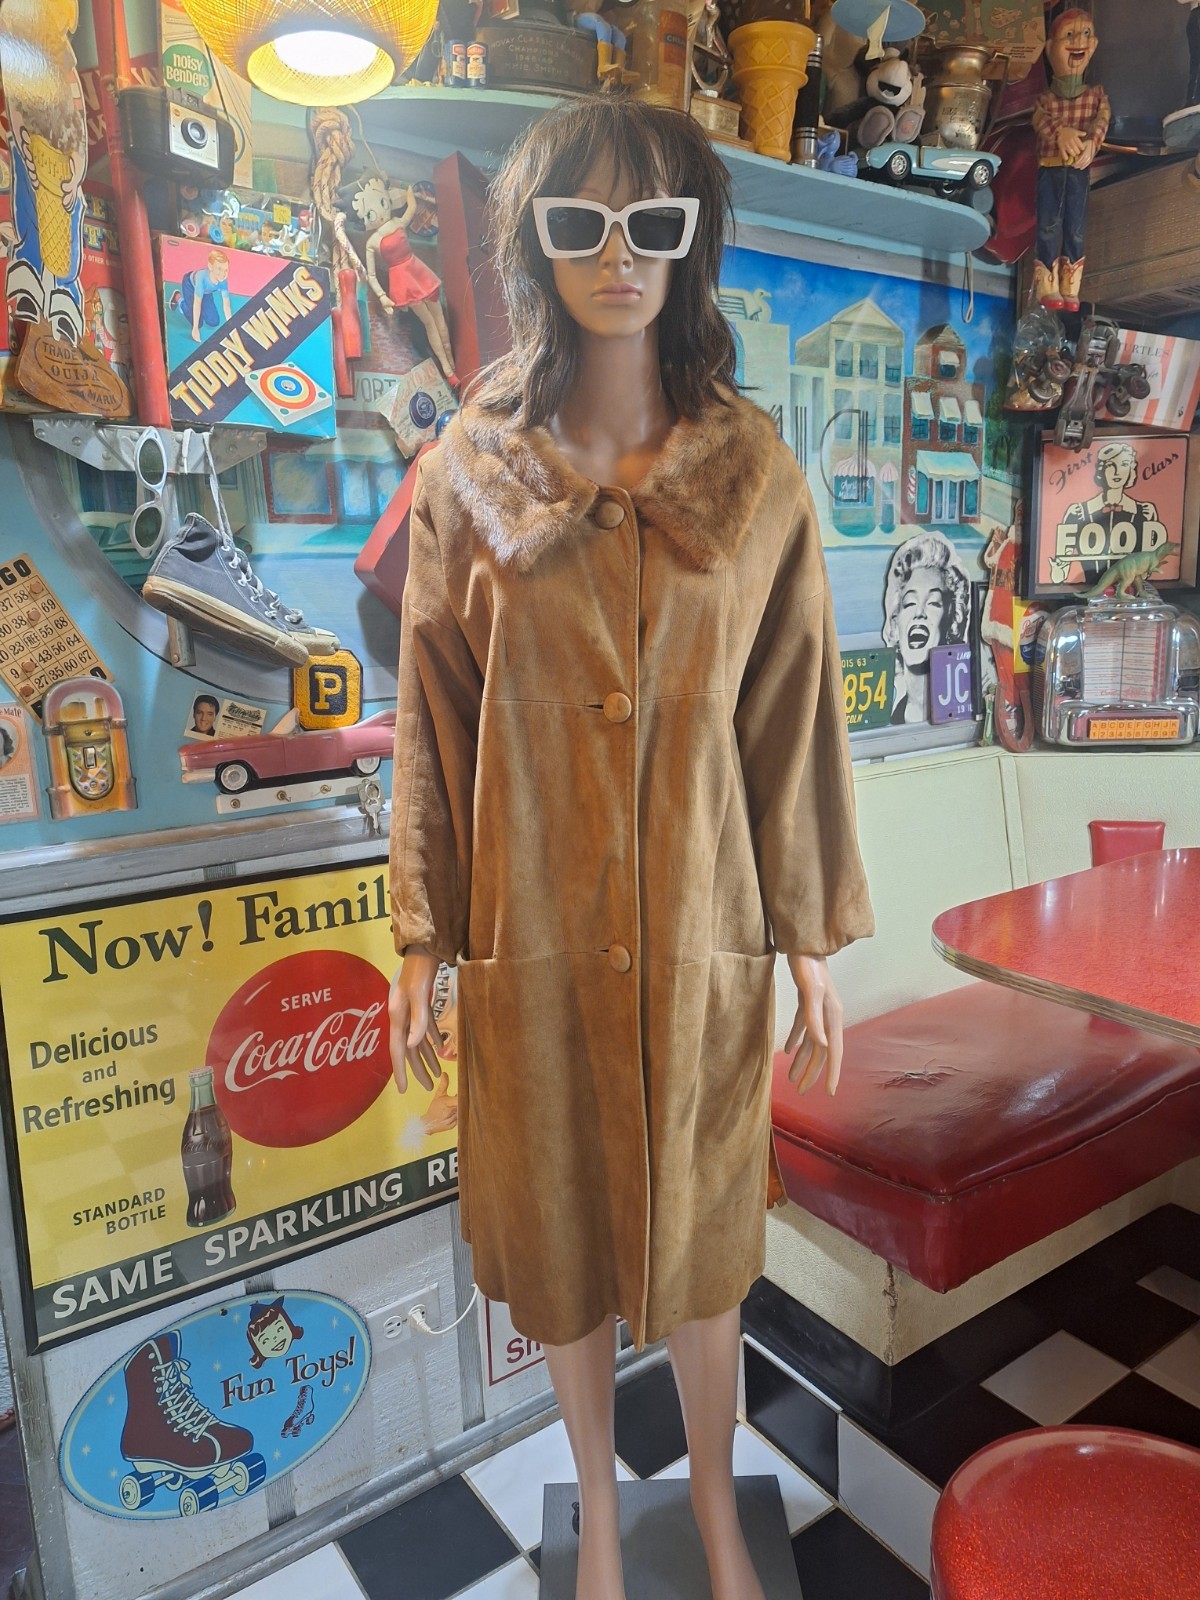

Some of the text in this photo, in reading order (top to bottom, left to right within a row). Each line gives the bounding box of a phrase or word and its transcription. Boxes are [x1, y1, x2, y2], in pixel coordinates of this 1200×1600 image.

[172, 53, 203, 71] noisy
[240, 266, 324, 350] WINKS
[42, 341, 78, 361] TRADE
[50, 363, 100, 382] OUIJA
[1048, 451, 1093, 496] First
[1142, 452, 1179, 481] Class
[1056, 521, 1168, 556] FOOD
[0, 558, 31, 590] GO
[11, 615, 27, 630] 38
[40, 598, 57, 613] 69
[13, 589, 29, 605] 58
[9, 641, 25, 657] 23
[24, 632, 41, 648] FREE
[38, 624, 54, 639] 55
[53, 616, 69, 630] 68
[9, 633, 82, 680] 9 43 56 64
[35, 674, 50, 690] 27
[48, 666, 64, 682] 35
[63, 658, 79, 673] 60
[78, 649, 93, 664] 67
[857, 658, 867, 668] 63
[314, 671, 342, 710] P
[38, 873, 394, 984] Now! Famil
[280, 987, 332, 1013] SERVE
[29, 1023, 159, 1070] Delicious
[224, 1000, 387, 1093] Coca-Cola
[82, 1060, 117, 1084] and
[22, 1077, 176, 1134] Refreshing
[72, 1187, 166, 1226] STANDARD
[105, 1204, 167, 1235] BOTTLE
[51, 1152, 459, 1319] SAME SPARKLING RE
[219, 1335, 356, 1410] Fun Toys!
